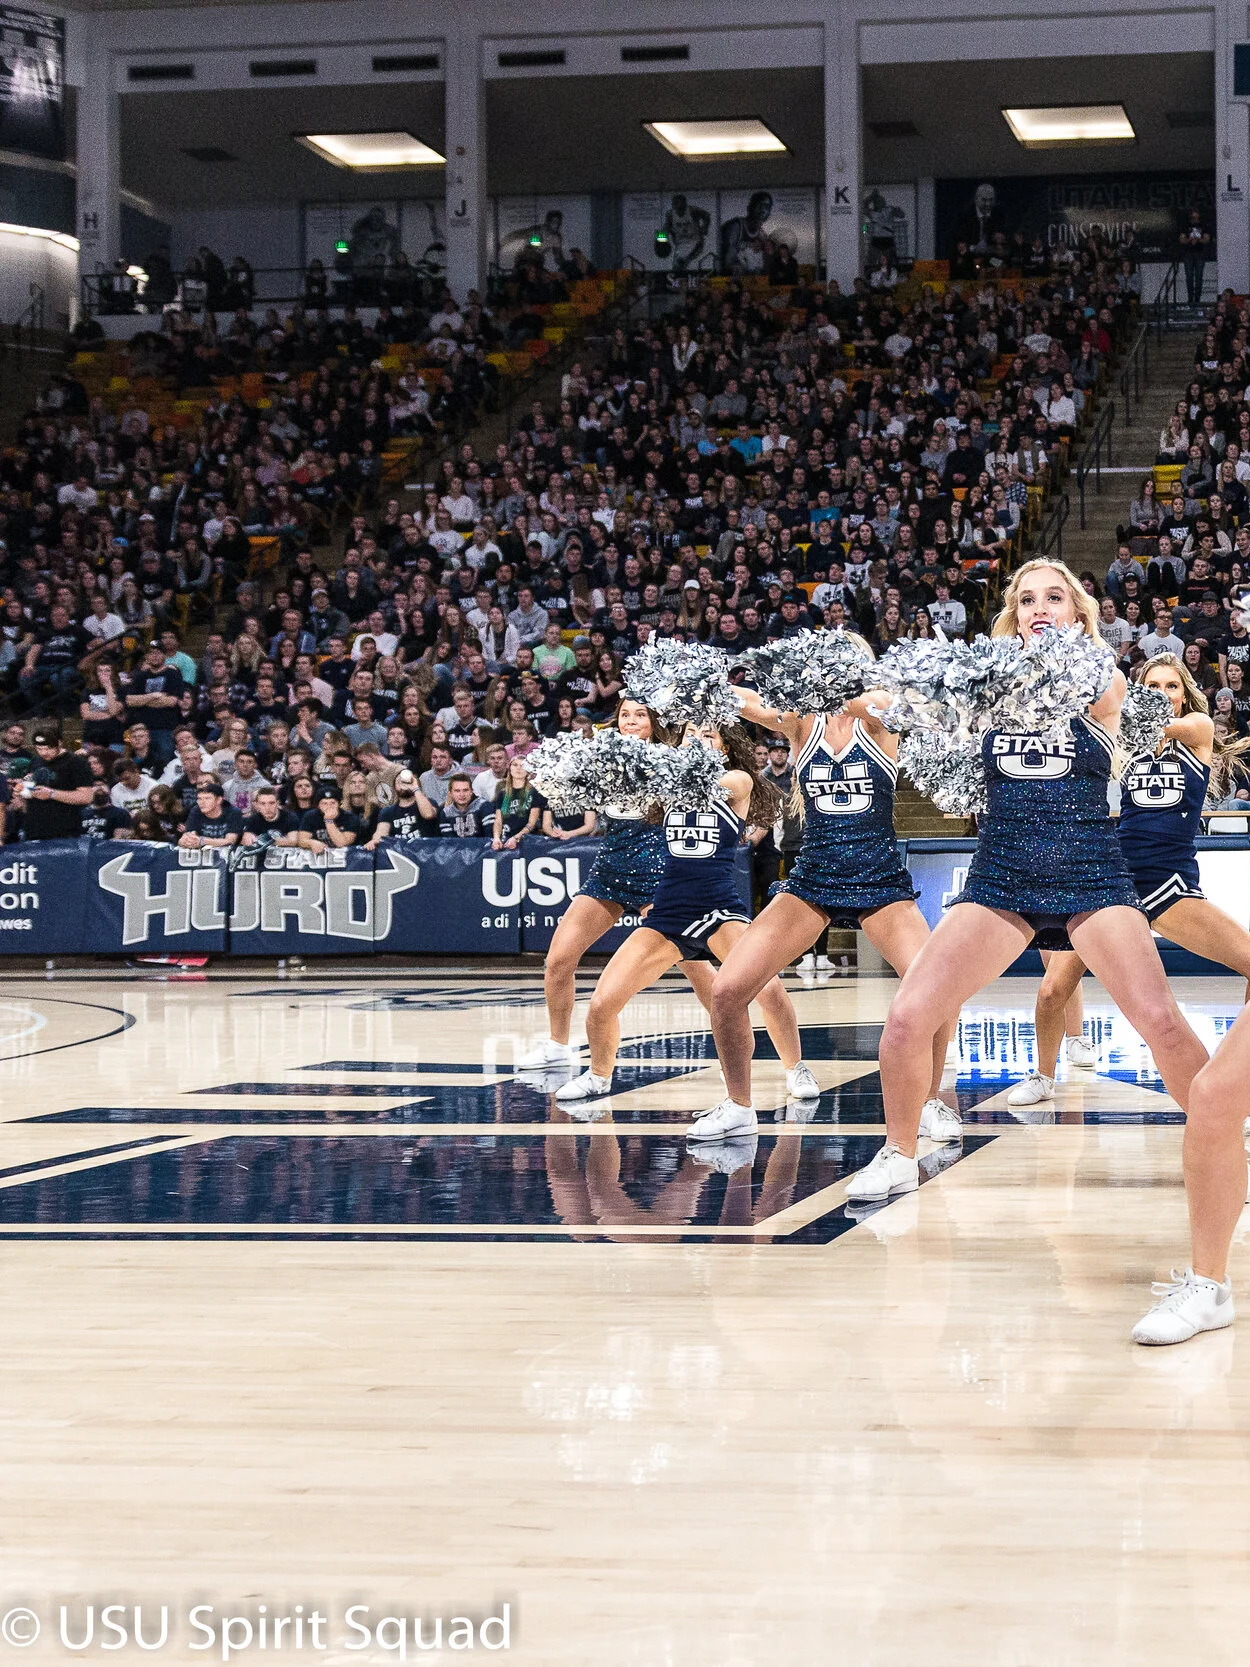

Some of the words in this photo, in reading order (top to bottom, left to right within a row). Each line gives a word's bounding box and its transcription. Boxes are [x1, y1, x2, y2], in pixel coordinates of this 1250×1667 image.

[1227, 174, 1241, 192] L
[834, 186, 850, 204] K
[1149, 180, 1215, 210] STA
[455, 199, 467, 217] J
[84, 212, 98, 229] H
[992, 734, 1077, 758] STATE
[805, 778, 875, 798] STATE
[1128, 774, 1186, 790] STATE
[666, 827, 720, 844] STATE
[98, 851, 419, 945] HURD
